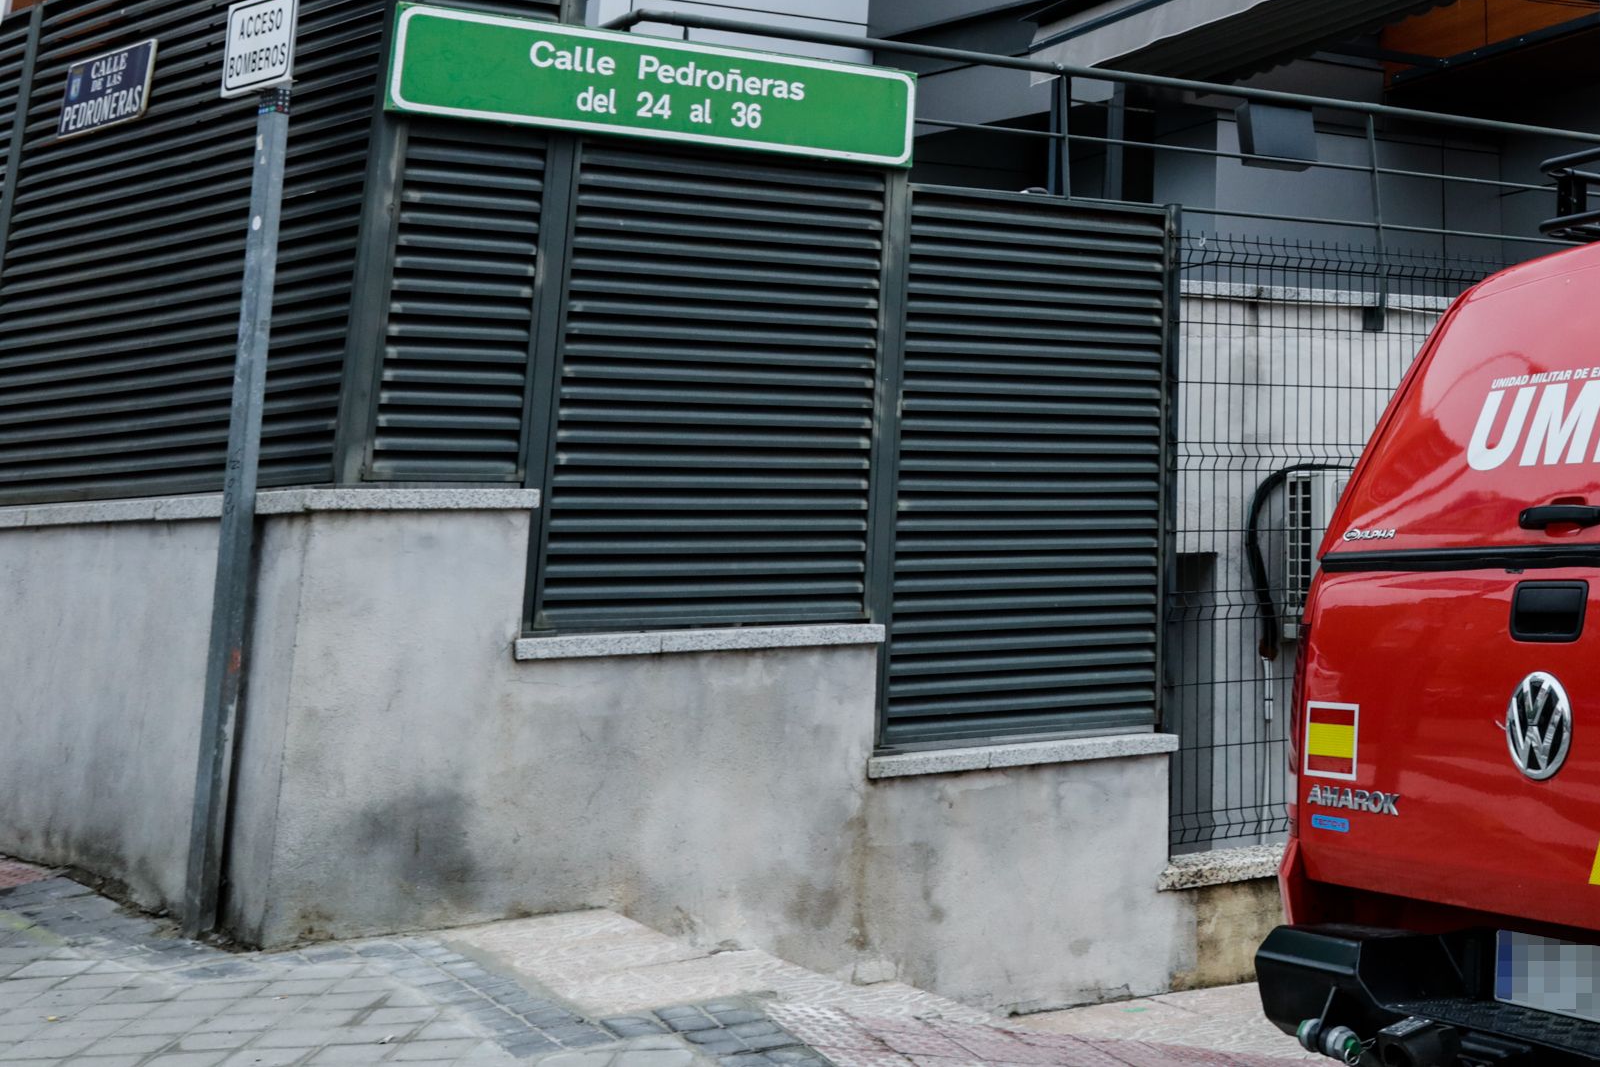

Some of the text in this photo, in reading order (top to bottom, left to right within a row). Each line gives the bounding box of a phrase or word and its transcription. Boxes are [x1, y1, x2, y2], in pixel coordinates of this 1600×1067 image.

[239, 8, 283, 40] ACCESO
[91, 53, 128, 80] CALLE
[228, 43, 287, 79] BOMBEROS
[529, 40, 805, 102] Calle Pedroñeras
[90, 72, 123, 92] DE LAS
[61, 85, 142, 133] PEDROÑERAS
[576, 86, 762, 129] del 24 al 36
[1491, 375, 1528, 389] UNIDAD
[1530, 369, 1573, 384] MILITAR
[1573, 368, 1590, 380] DE
[1358, 528, 1396, 540] ALPHA
[1307, 784, 1400, 816] AMAROK
